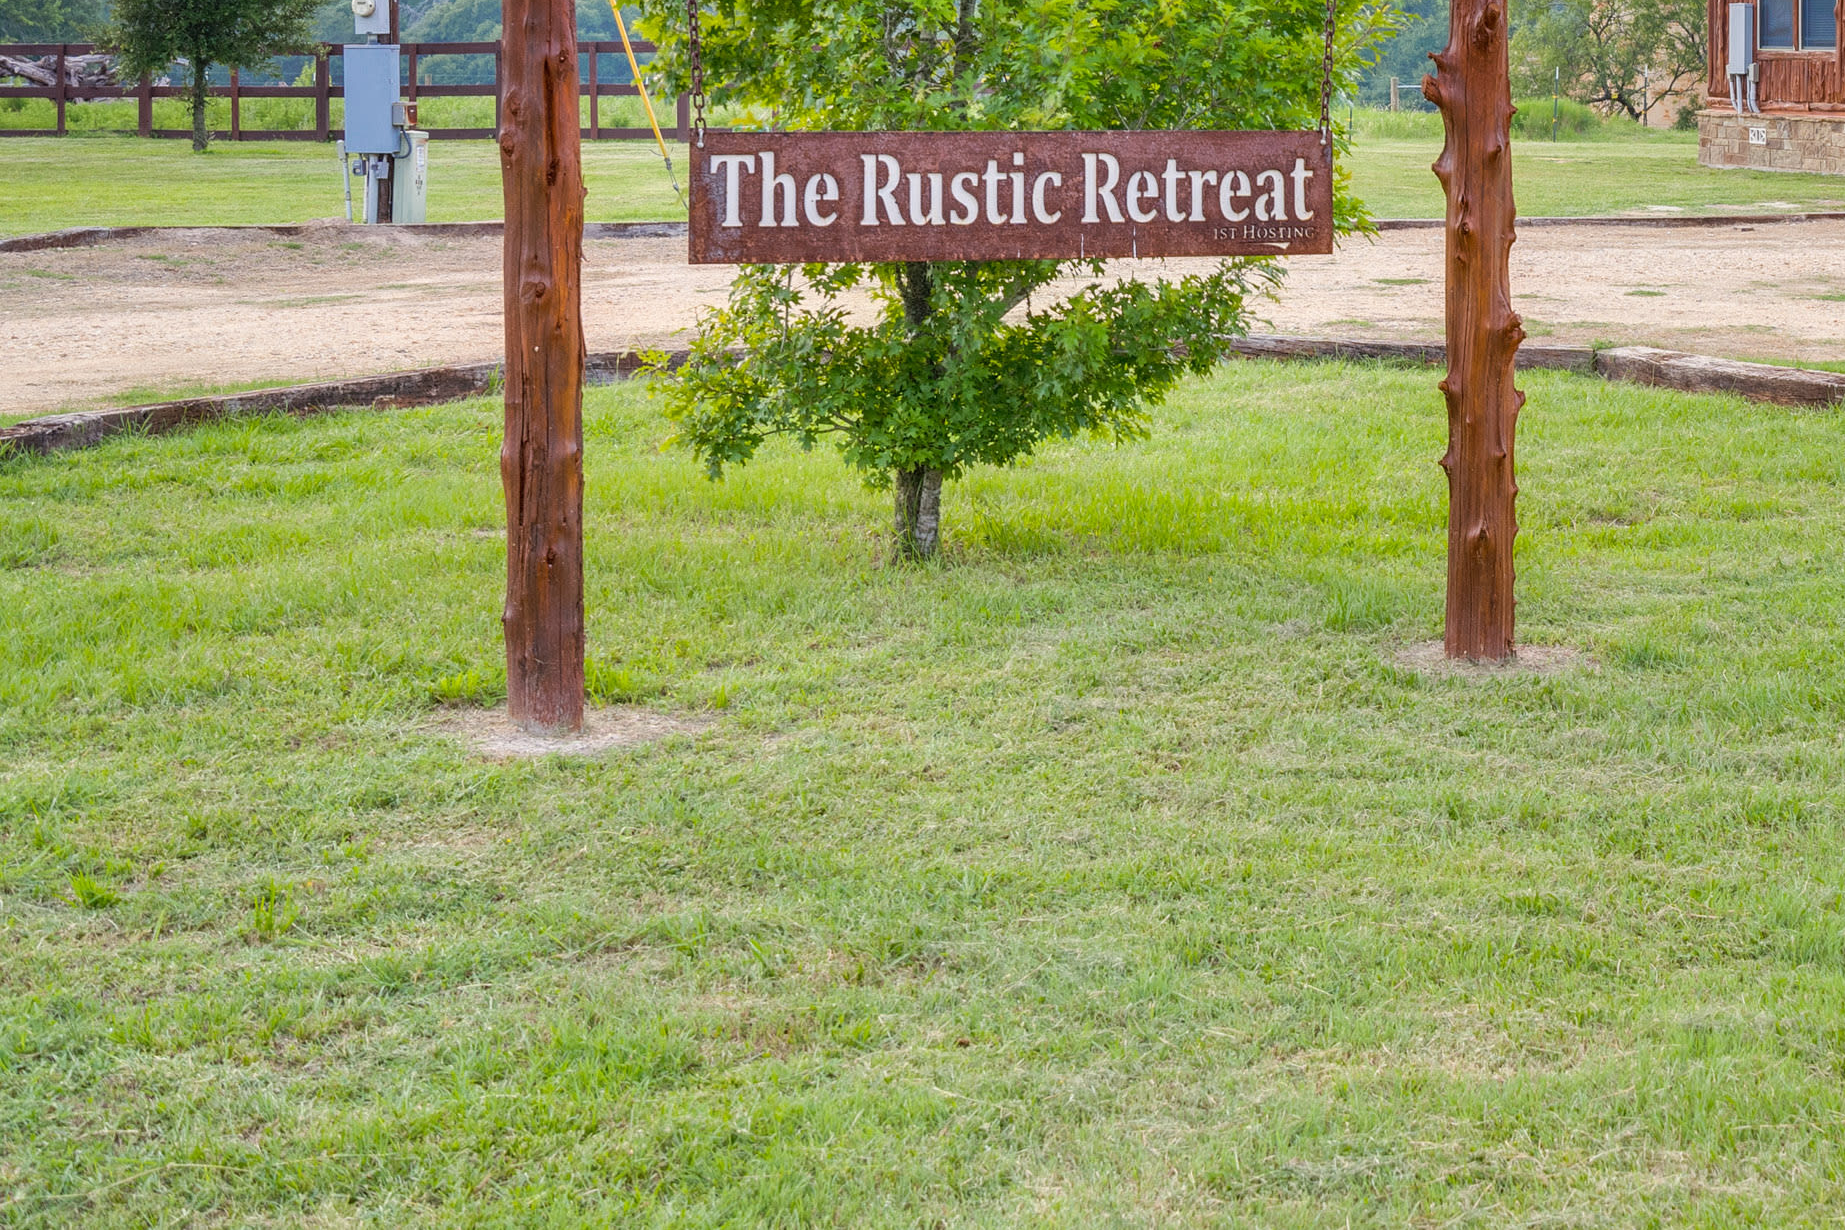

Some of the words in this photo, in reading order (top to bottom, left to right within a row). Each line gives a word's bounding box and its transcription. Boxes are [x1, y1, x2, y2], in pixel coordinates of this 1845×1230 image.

[709, 151, 839, 228] The
[860, 152, 1062, 226] Rustic
[1081, 152, 1314, 224] Retreat
